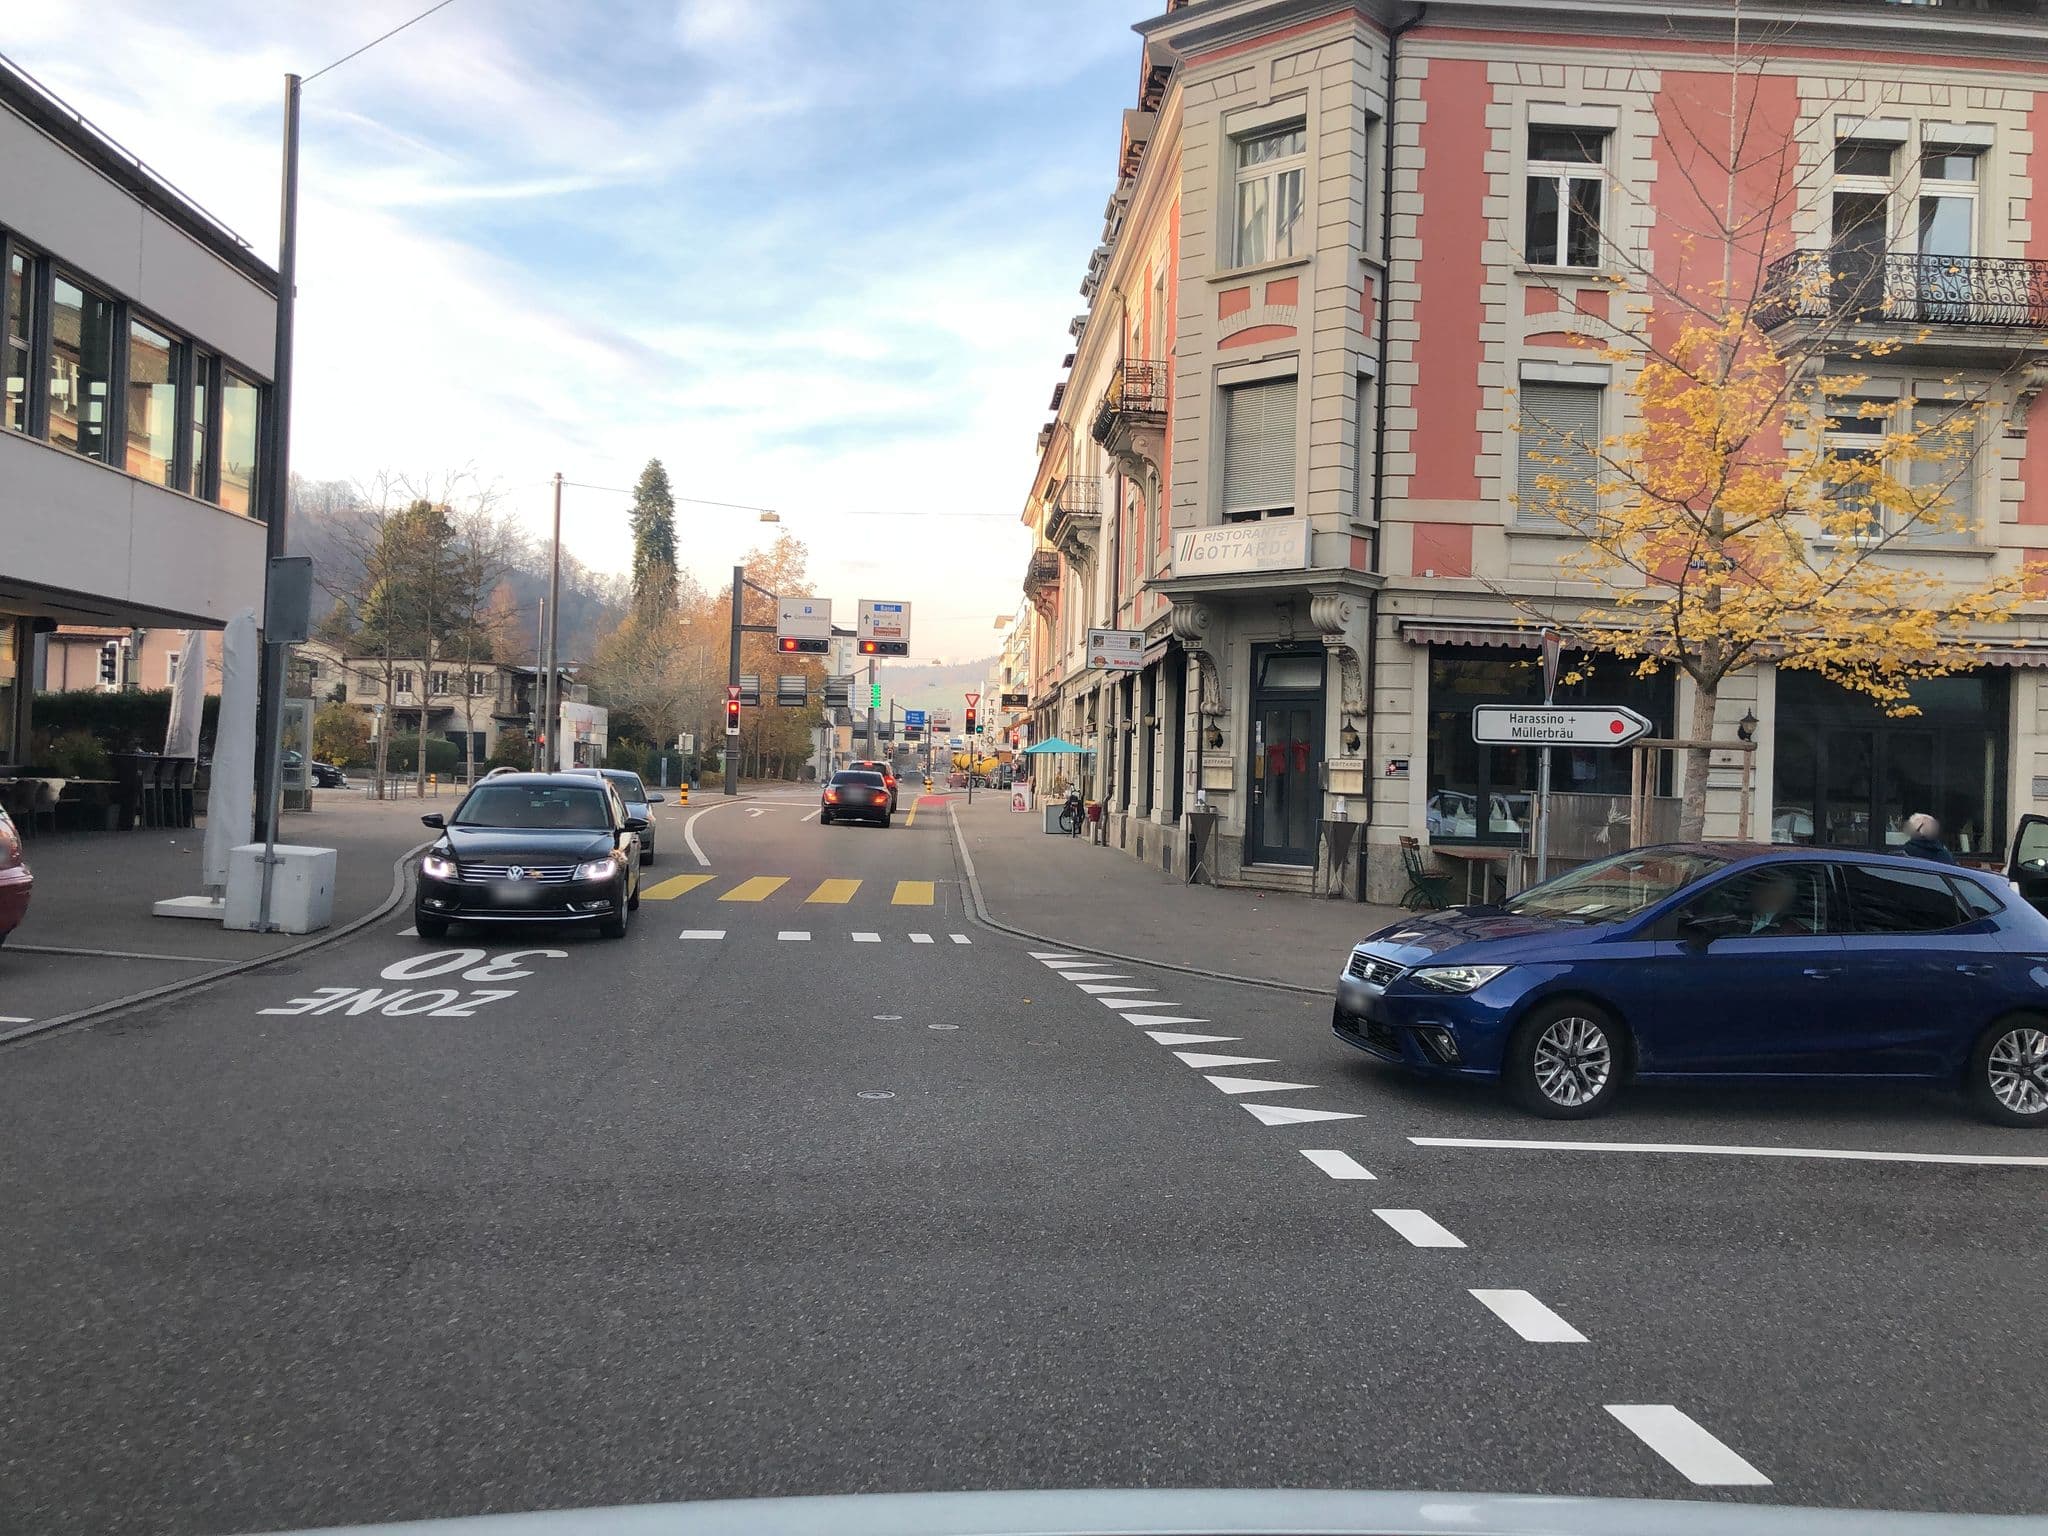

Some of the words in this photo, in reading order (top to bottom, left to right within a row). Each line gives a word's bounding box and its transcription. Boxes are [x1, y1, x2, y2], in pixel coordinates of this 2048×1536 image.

[1203, 527, 1289, 543] RISTORANTE
[1194, 540, 1296, 561] GOTTARDO
[1509, 713, 1564, 724] Harassino
[1568, 716, 1576, 724] +
[1511, 726, 1574, 739] Müllerbräu
[380, 949, 569, 982] 30
[255, 988, 520, 1017] ZONE
